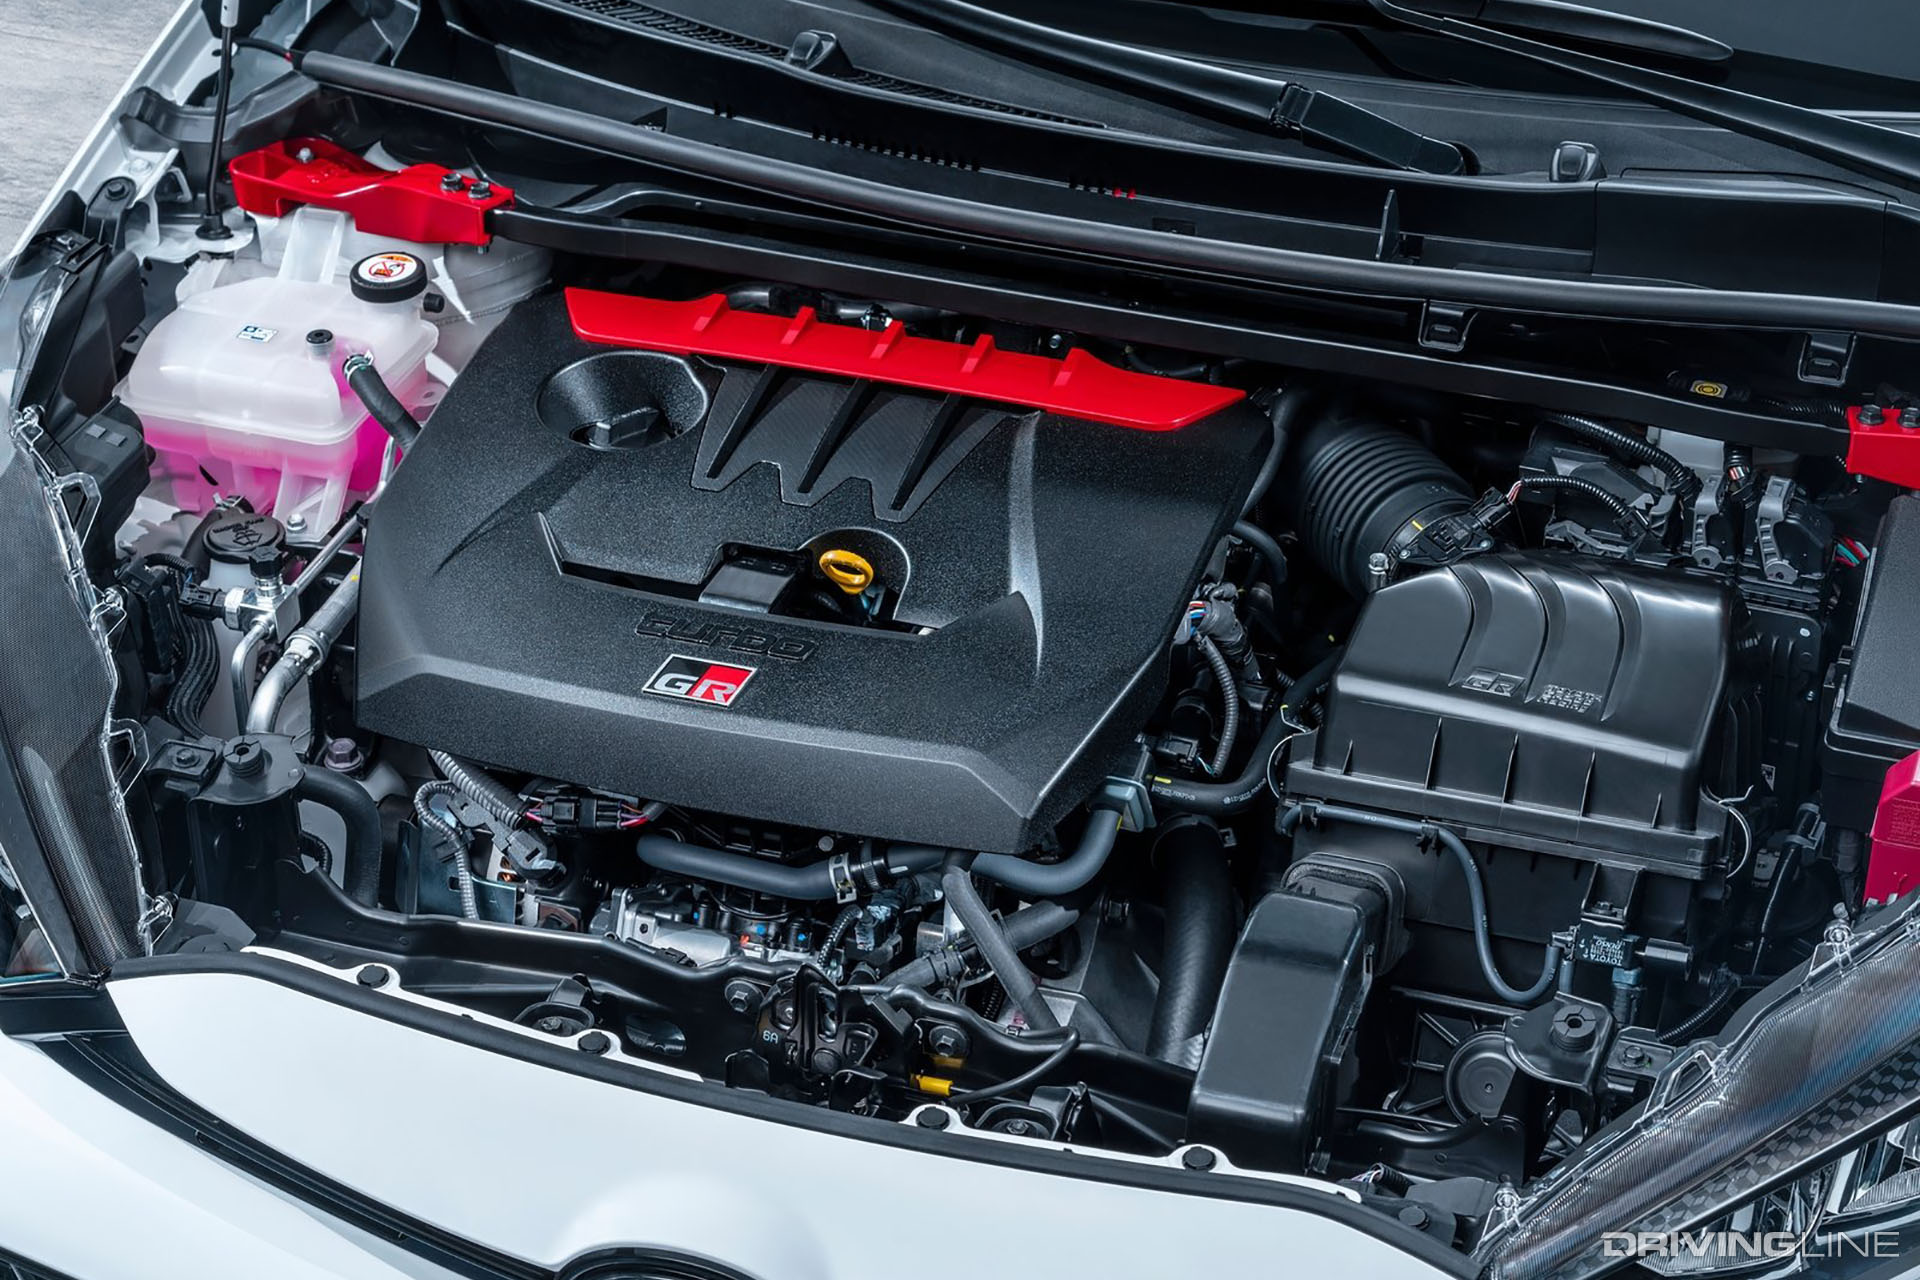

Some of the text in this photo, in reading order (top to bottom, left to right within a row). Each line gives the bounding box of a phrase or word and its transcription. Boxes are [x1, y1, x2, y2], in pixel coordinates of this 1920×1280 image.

[653, 672, 738, 703] GR
[1464, 675, 1517, 697] GR
[1590, 953, 1622, 966] TOYOTA
[762, 1029, 779, 1045] 6A
